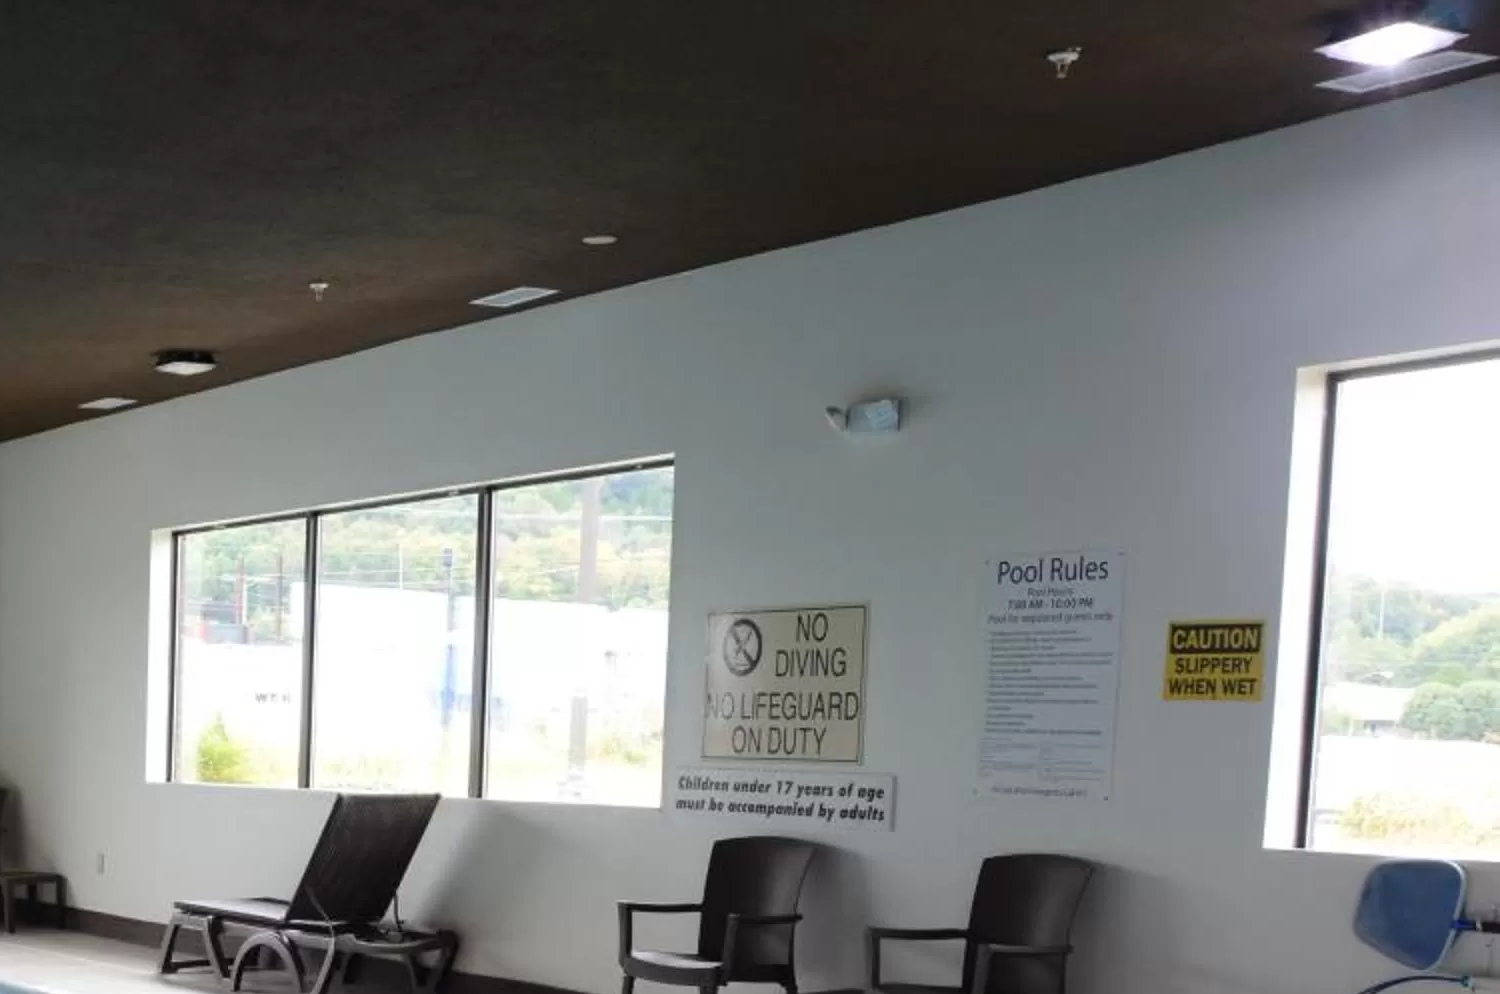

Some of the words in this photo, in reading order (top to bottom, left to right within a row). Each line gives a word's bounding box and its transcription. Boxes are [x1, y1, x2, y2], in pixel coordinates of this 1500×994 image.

[997, 557, 1044, 585] Pool
[1050, 555, 1109, 581] Rules
[796, 613, 829, 642] NO
[1173, 627, 1259, 650] CAUTION
[774, 647, 847, 678] DIVING
[1174, 656, 1253, 674] SLIPPERY
[1169, 678, 1216, 695] WHEN
[1222, 678, 1257, 695] WET
[704, 692, 735, 720] NO
[741, 691, 859, 722] LIFEGUARD
[731, 725, 761, 755] ON
[767, 726, 827, 756] DUTY
[677, 775, 729, 791] Children
[733, 778, 772, 794] under
[776, 781, 794, 795] 17
[796, 785, 834, 799] years
[838, 781, 853, 797] of
[857, 787, 885, 803] age
[675, 797, 706, 810] must
[707, 797, 725, 811] be
[727, 799, 813, 818] accompanied
[817, 802, 836, 822] by
[839, 804, 885, 822] adults
